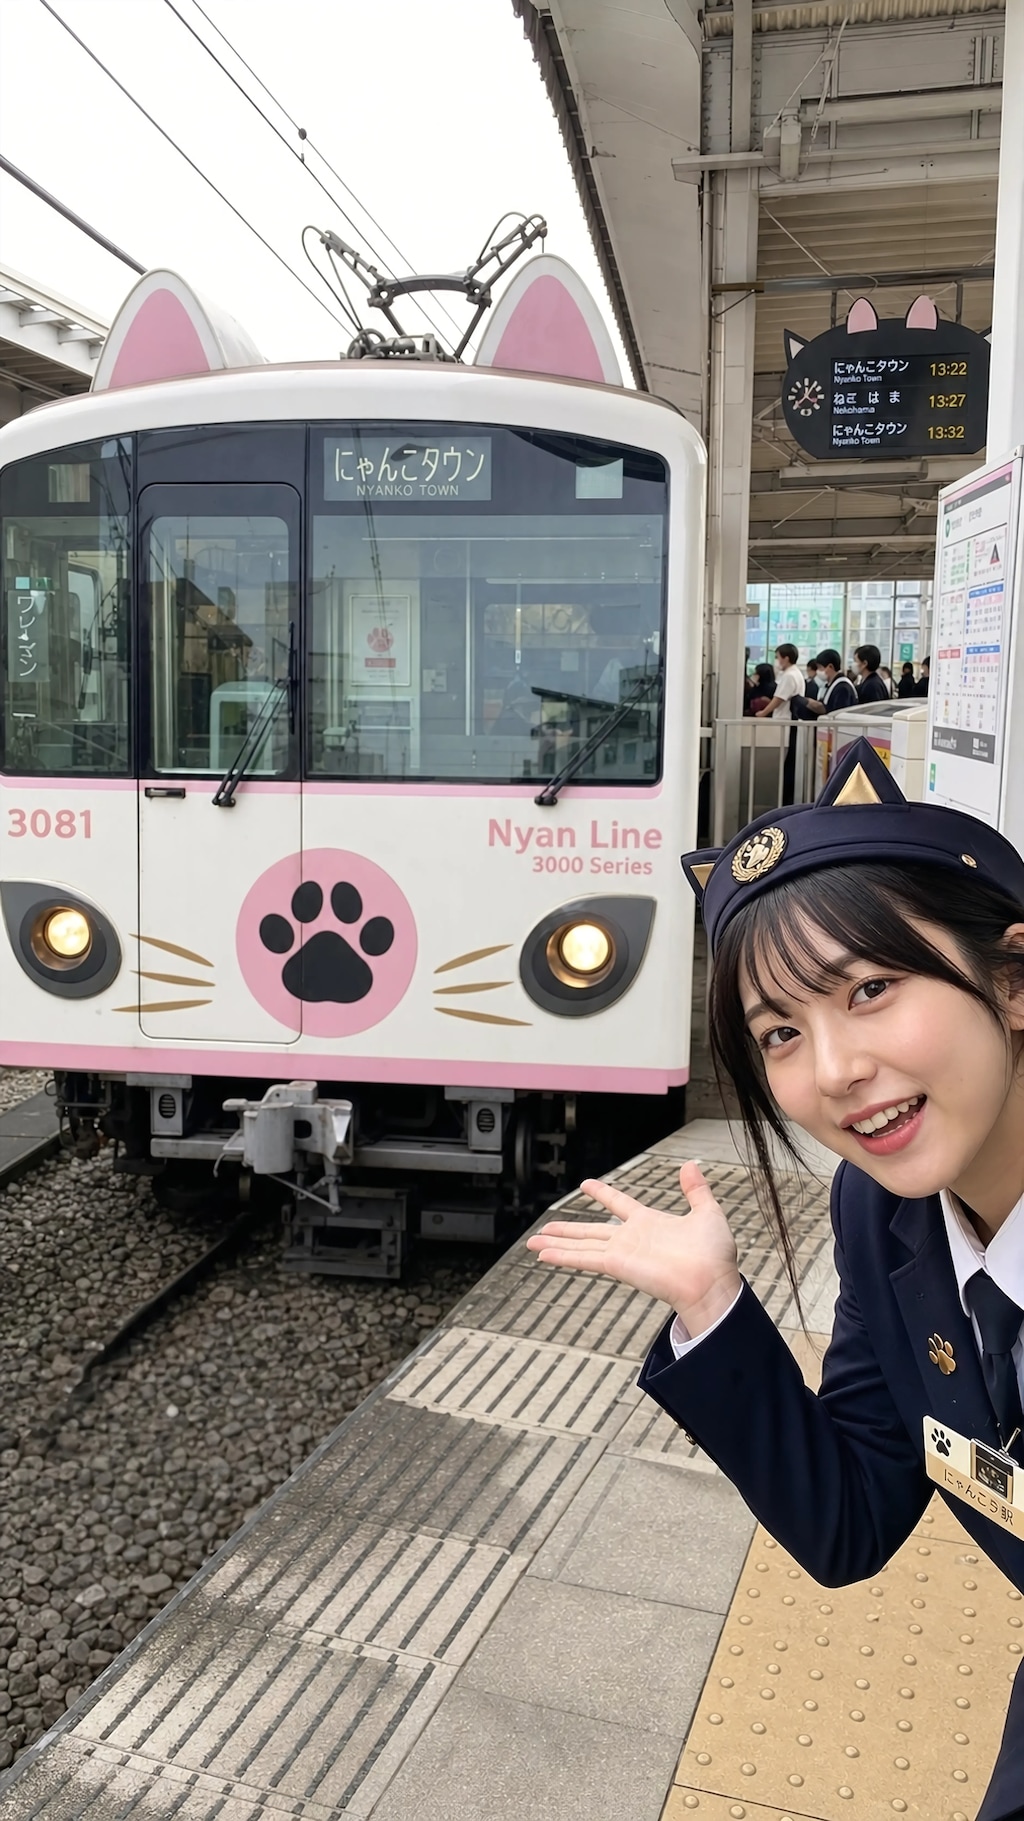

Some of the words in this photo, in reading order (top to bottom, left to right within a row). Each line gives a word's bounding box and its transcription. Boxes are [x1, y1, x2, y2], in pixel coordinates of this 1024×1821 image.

[834, 359, 909, 374] にゃんこタウン
[930, 362, 967, 376] 13:22
[862, 374, 883, 382] Town
[929, 394, 966, 408] 13:27
[832, 422, 907, 436] にゃんこタウン
[928, 426, 965, 439] 13:32
[335, 446, 484, 482] にゃんこタウン
[356, 484, 413, 496] NYANKO
[419, 484, 459, 496] TOWN
[8, 808, 91, 839] 3081
[488, 819, 576, 854] Nyan
[591, 820, 662, 849] Line
[532, 856, 584, 873] 3000
[590, 857, 653, 875] Series
